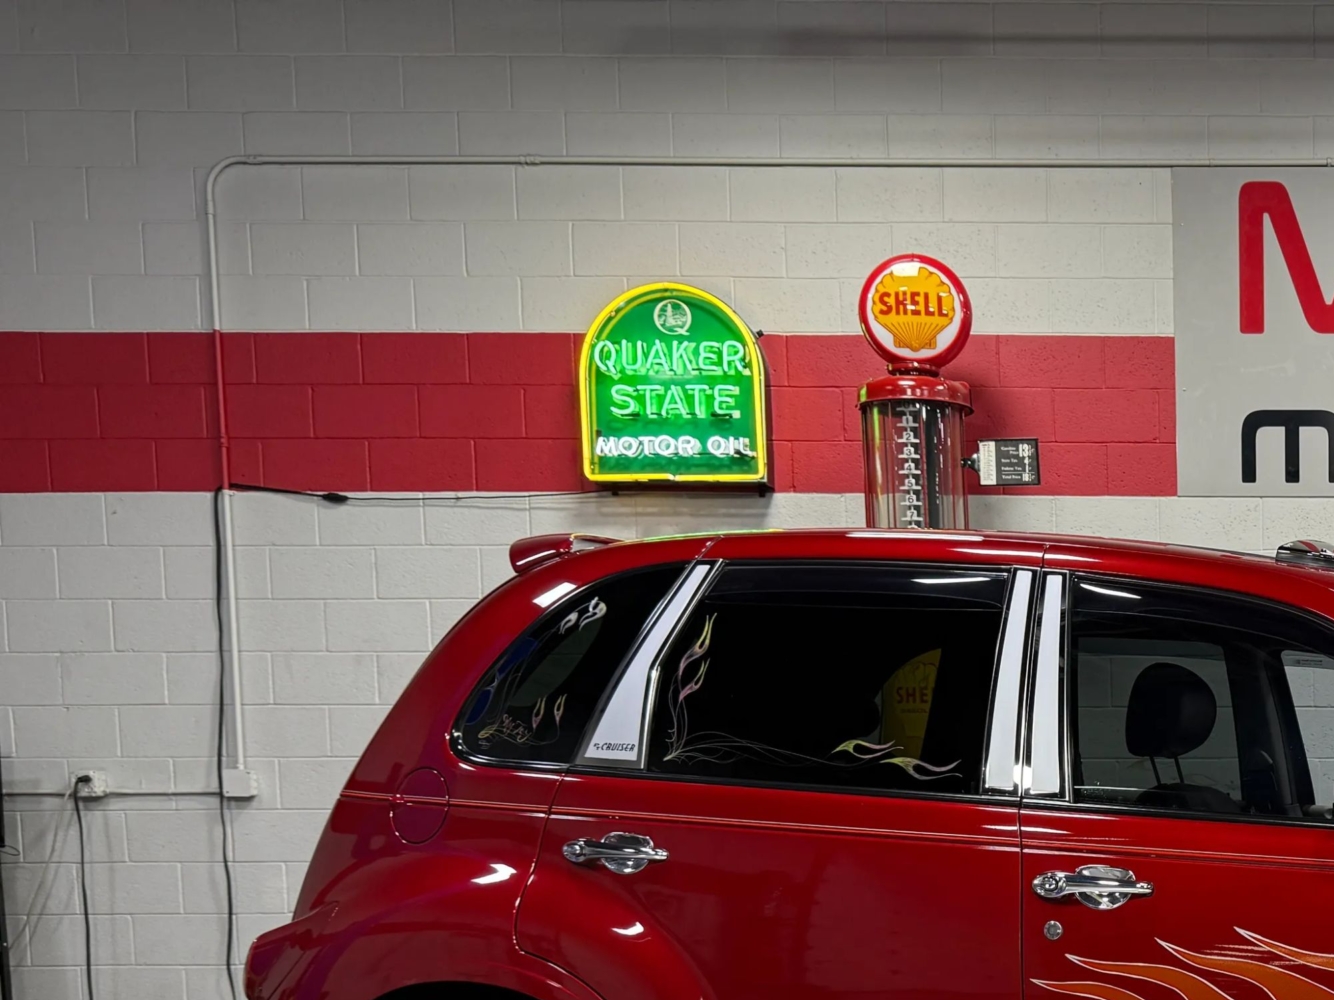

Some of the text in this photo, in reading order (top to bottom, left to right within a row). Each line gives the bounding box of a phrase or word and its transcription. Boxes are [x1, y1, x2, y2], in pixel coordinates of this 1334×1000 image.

[878, 291, 949, 318] SHELL
[594, 339, 751, 380] QUAKER
[610, 384, 741, 419] STATE
[905, 432, 911, 440] 2
[595, 435, 757, 458] MOTOR OIL
[906, 448, 912, 456] 3
[907, 480, 913, 488] 5
[908, 495, 914, 503] 6
[909, 511, 915, 519] 7
[896, 686, 930, 704] SHE
[601, 742, 636, 752] CRUISER
